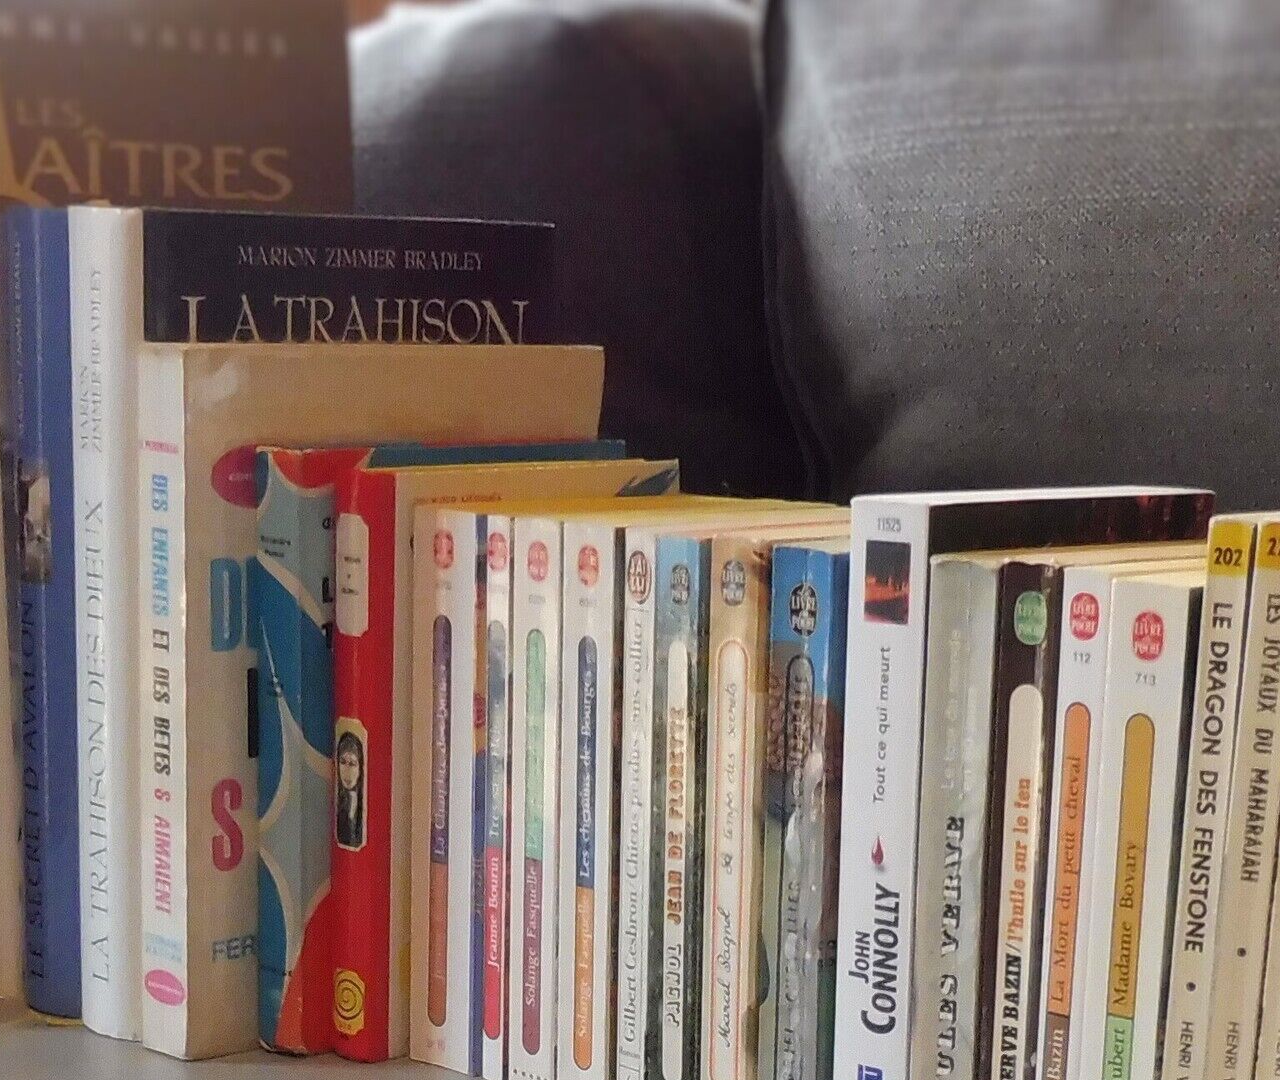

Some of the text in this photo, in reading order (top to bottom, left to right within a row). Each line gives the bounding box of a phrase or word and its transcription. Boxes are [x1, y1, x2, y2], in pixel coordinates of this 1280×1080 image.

[16, 97, 84, 130] LES
[238, 246, 485, 272] MARION ZIMMER BRADLEY
[273, 294, 530, 345] TRAHISON
[1214, 546, 1243, 567] 202
[152, 628, 170, 653] ET
[1073, 651, 1091, 664] 112
[152, 664, 170, 704] DES
[84, 498, 111, 983] LA TRAHISON DES DIEUX
[872, 646, 891, 804] Tout ce qui meurt
[1252, 728, 1273, 755] DU
[1182, 601, 1233, 954] LE DRAGON DES FENSTONE
[667, 830, 683, 860] DE
[1240, 767, 1269, 882] MAHARAJAH
[579, 850, 591, 878] Les
[940, 815, 966, 957] VERNE
[1051, 755, 1081, 1003] La Mort du petit cheval
[666, 869, 683, 926] JEAN
[1113, 841, 1140, 1007] Madame Bovary
[486, 909, 500, 970] Jeanne
[717, 906, 736, 974] Pagnol
[848, 930, 871, 985] JOHN
[860, 883, 901, 1035] CONNOLLY
[524, 945, 541, 1008] Solange
[665, 943, 682, 1028] PAGNOL
[623, 976, 638, 1043] Gilbert
[717, 978, 731, 1048] Marcel
[1176, 1020, 1194, 1069] HENRI
[1222, 1020, 1240, 1069] HENRI
